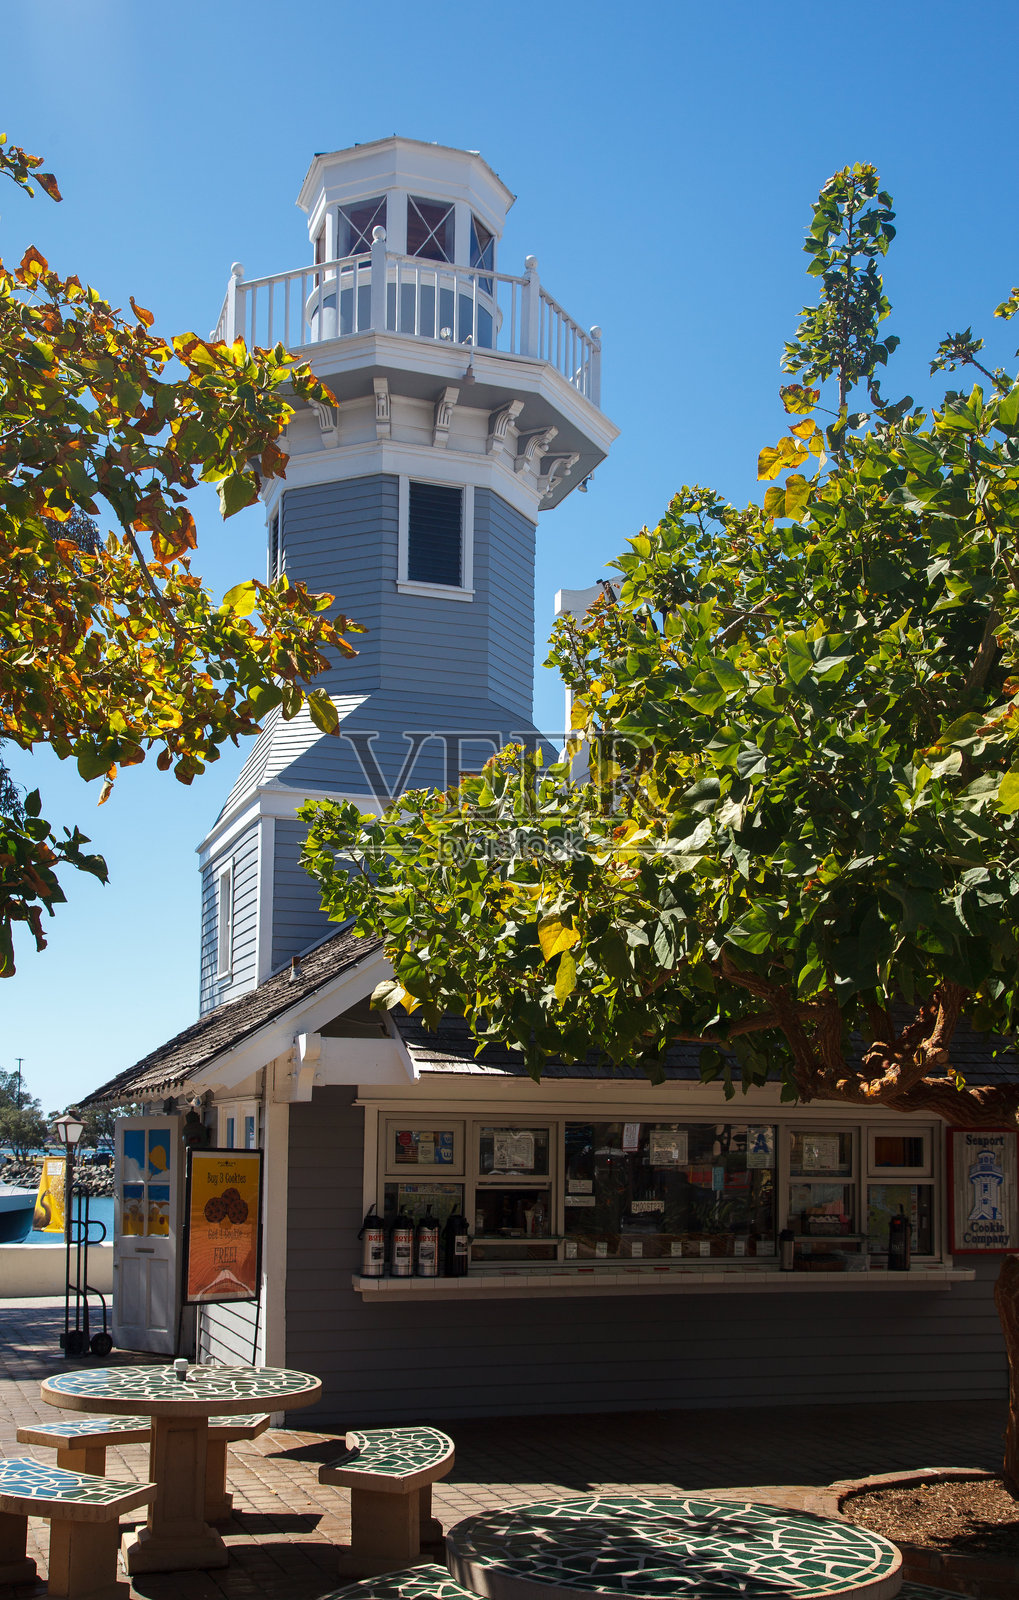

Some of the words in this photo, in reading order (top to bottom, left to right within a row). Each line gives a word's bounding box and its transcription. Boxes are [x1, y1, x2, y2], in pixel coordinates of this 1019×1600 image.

[753, 1134, 769, 1153] A
[966, 1134, 1004, 1148] Seaport
[225, 1172, 247, 1184] Cookies
[971, 1222, 1005, 1233] Cookie
[964, 1233, 1010, 1246] Company
